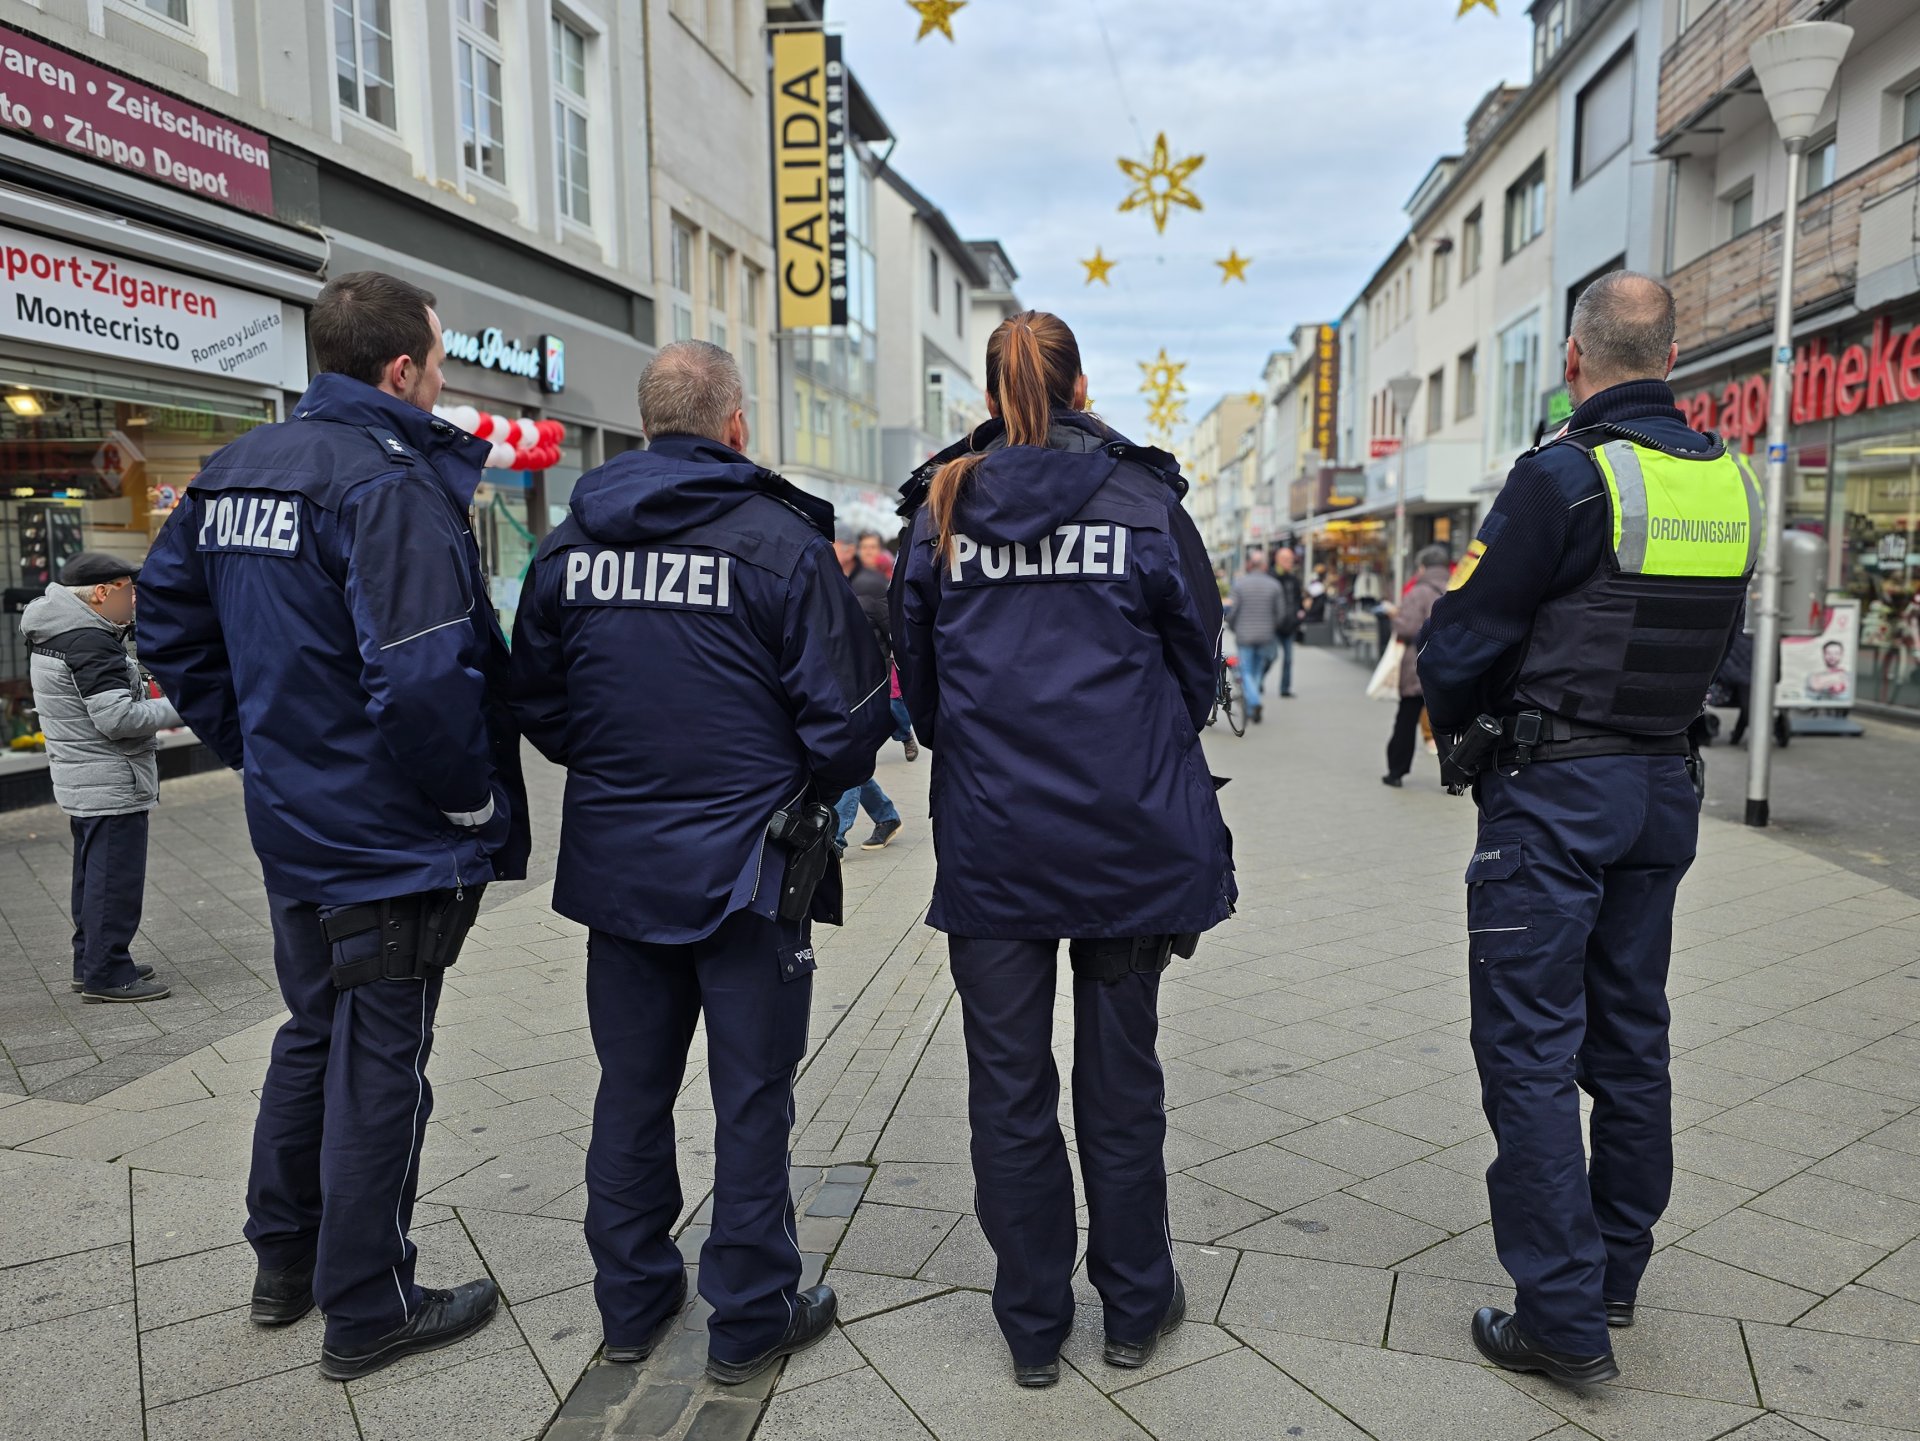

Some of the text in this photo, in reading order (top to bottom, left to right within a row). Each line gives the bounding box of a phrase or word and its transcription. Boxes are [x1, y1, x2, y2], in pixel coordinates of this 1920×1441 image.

[0, 44, 270, 170] aren Zeitschriften
[64, 114, 146, 168] Zippo
[153, 147, 229, 198] Depot
[781, 65, 825, 298] CALIDA
[827, 60, 846, 300] SWITZERLAND
[0, 245, 217, 319] port-Zigarren
[16, 292, 180, 351] Montecristo
[218, 341, 268, 372] Upmann
[1719, 315, 1920, 455] aptheke
[198, 496, 299, 552] POLIZEI
[950, 524, 1127, 583] POLIZEI
[1650, 515, 1747, 544] ORDNUNGSAMT
[566, 550, 730, 607] POLIZEI
